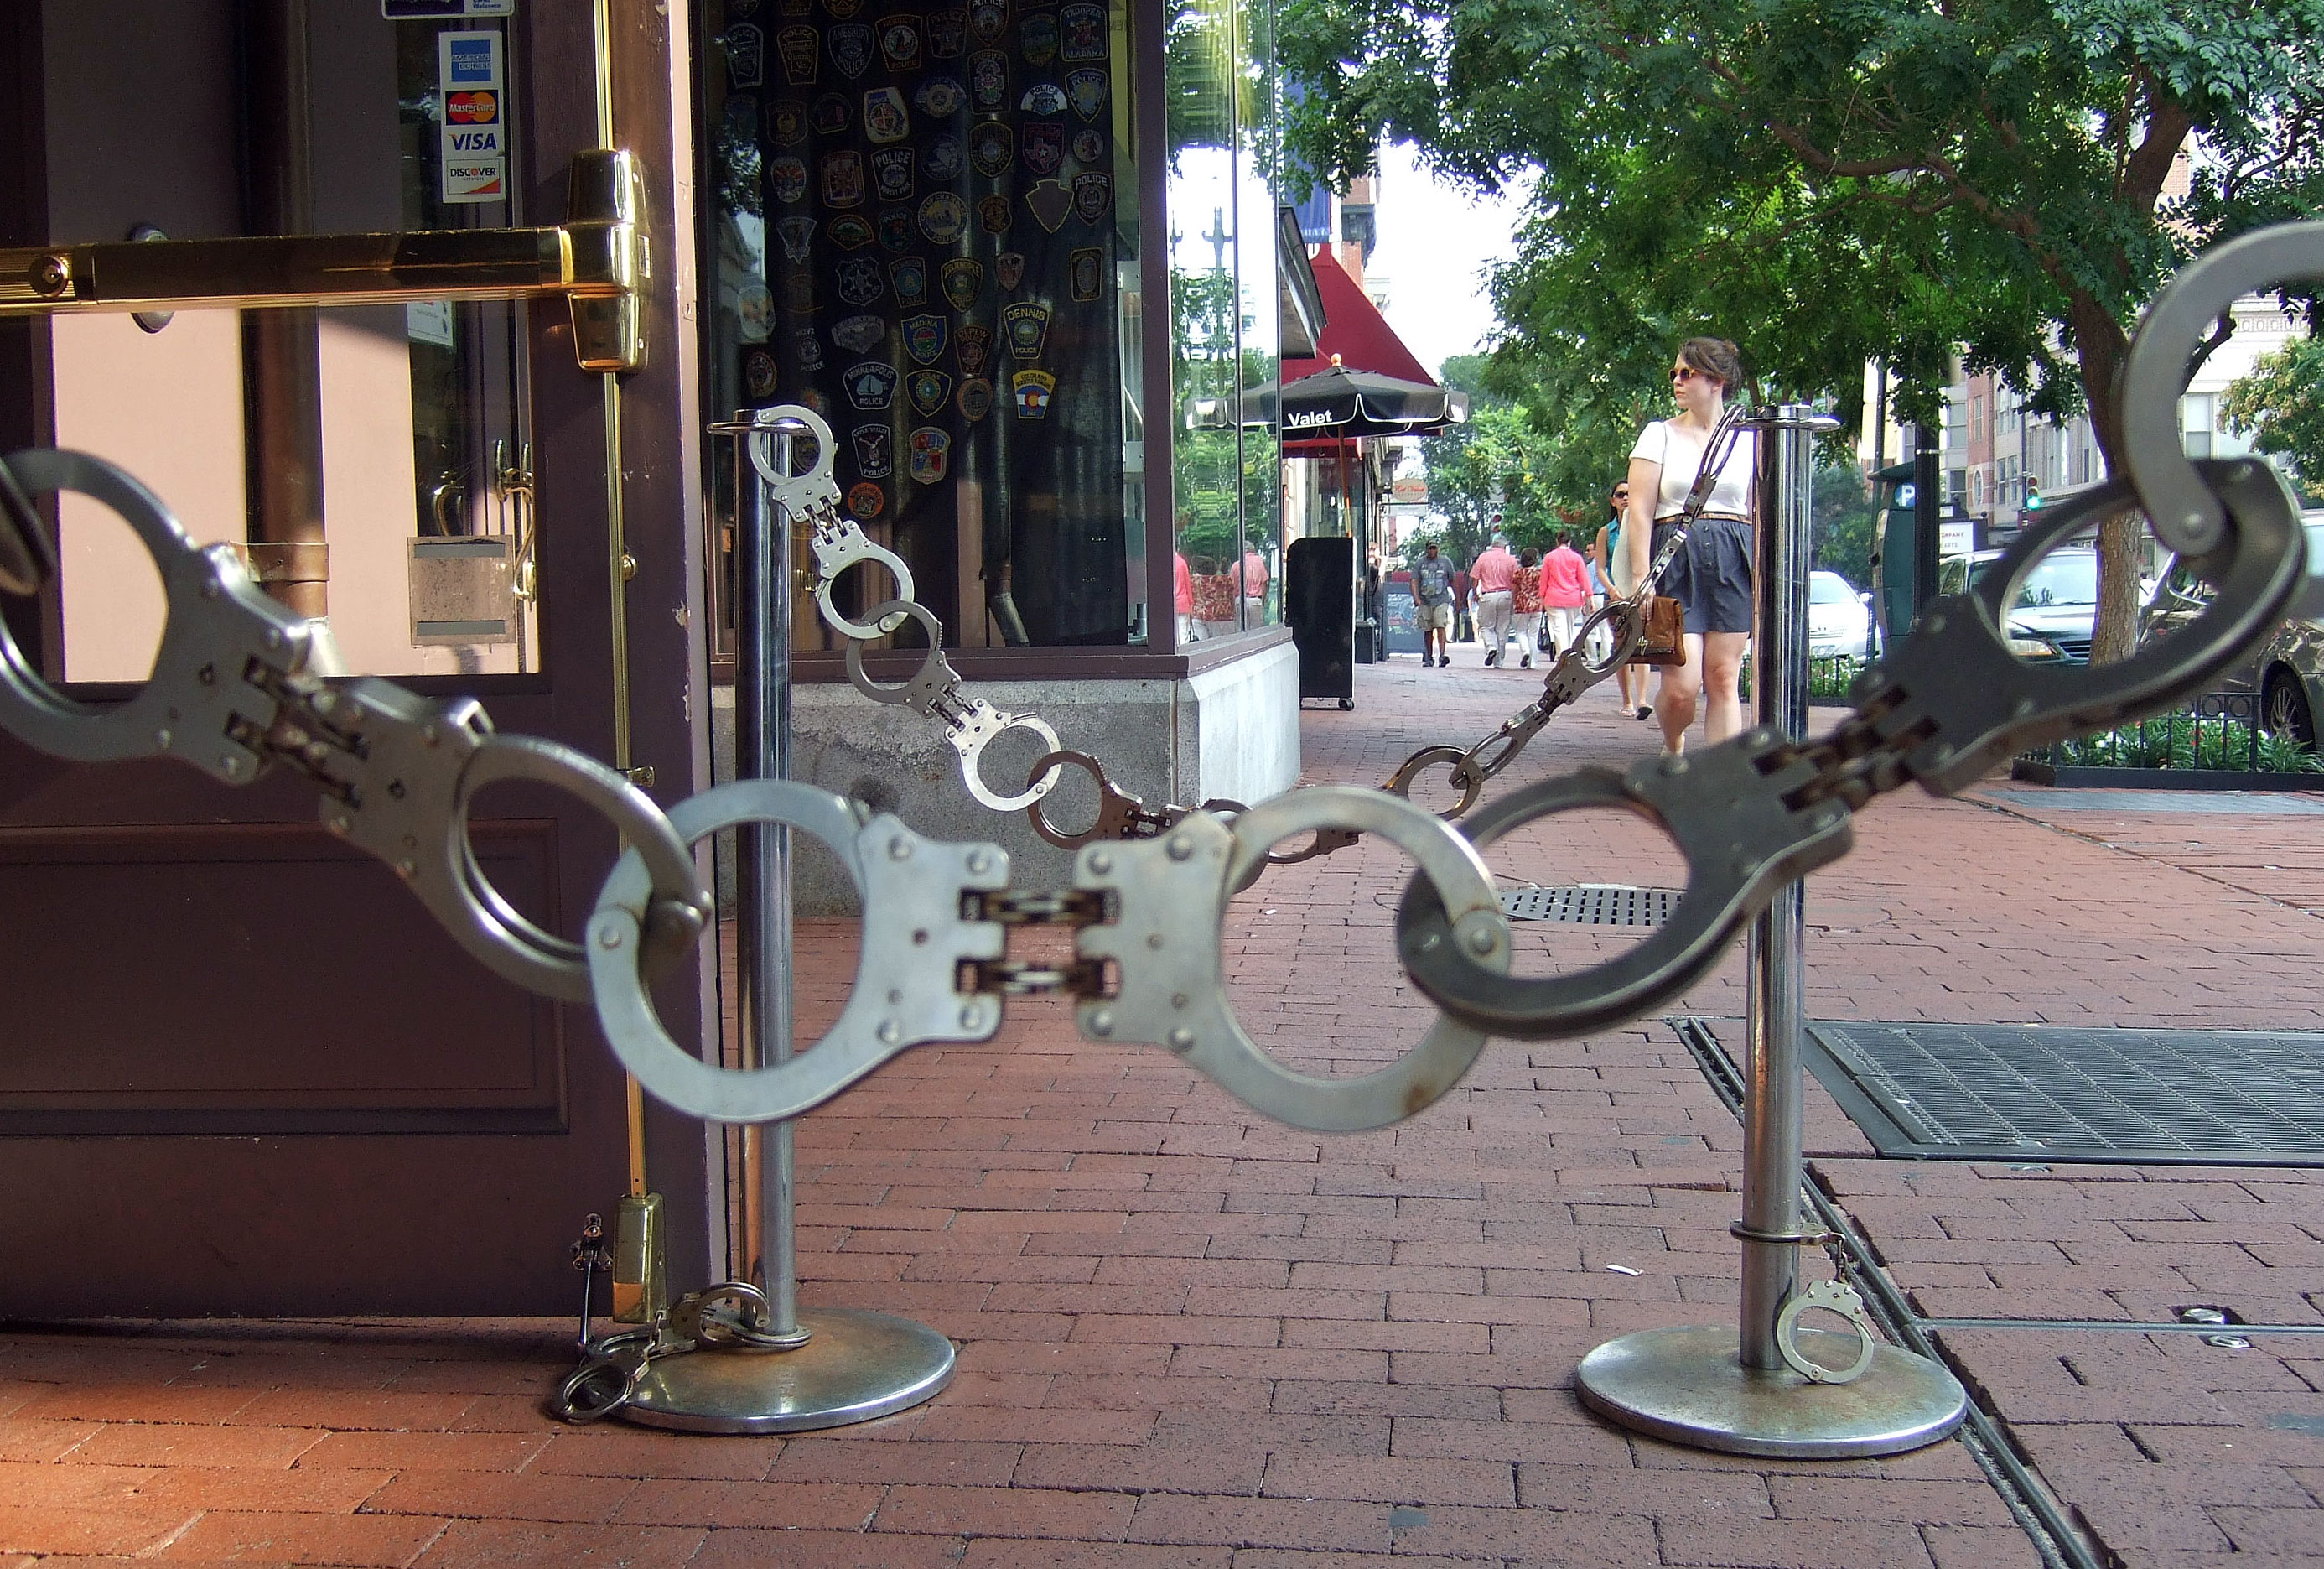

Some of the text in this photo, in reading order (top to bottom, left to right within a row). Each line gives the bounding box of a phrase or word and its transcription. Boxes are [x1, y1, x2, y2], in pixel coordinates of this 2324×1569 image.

[1064, 7, 1103, 18] TROOPER
[1065, 49, 1105, 59] ALABAMA
[1071, 75, 1102, 87] POLICE
[1030, 85, 1060, 96] POLICE
[449, 103, 495, 113] MasterCard
[450, 133, 497, 151] VISA
[874, 151, 911, 168] POLICE
[450, 168, 496, 178] DISCOVER
[1075, 174, 1108, 190] POLICE
[1007, 307, 1047, 321] DENNIS
[909, 319, 937, 330] MEDINA
[915, 349, 938, 359] POLICE
[847, 365, 894, 381] MINNEAPOLIS
[859, 397, 884, 406] POLICE
[1288, 409, 1332, 427] Valet
[864, 466, 890, 477] POLICE
[1901, 485, 1916, 507] P
